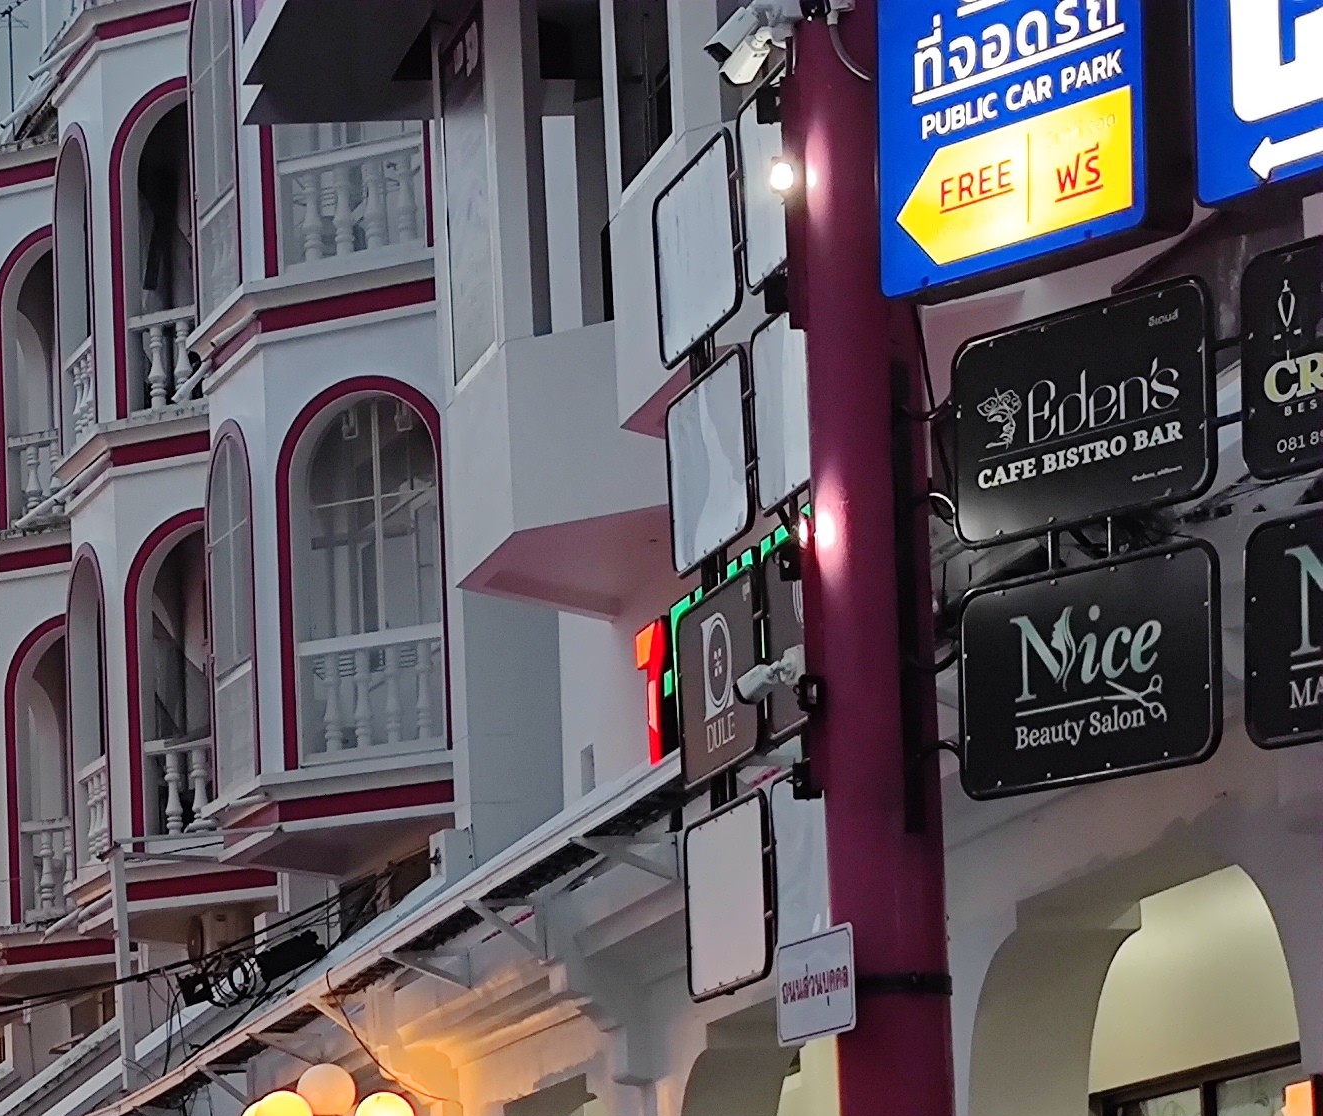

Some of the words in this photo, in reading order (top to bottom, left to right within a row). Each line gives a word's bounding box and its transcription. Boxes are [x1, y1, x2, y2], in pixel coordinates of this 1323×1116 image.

[921, 92, 998, 140] PUBLIC
[1006, 74, 1053, 111] CAR
[1060, 49, 1123, 93] PARK
[940, 159, 1013, 208] FREE
[1056, 142, 1102, 194] ฟรี
[1027, 356, 1180, 444] Eden's
[977, 458, 1037, 490] CAFE
[1042, 436, 1127, 475] BISTRO
[1132, 421, 1183, 450] BAR
[1276, 435, 1306, 453] 081
[1009, 605, 1162, 703] Nice
[1015, 719, 1086, 751] Beauty
[1089, 704, 1146, 737] Salon
[782, 963, 849, 1006] ถนนส่วนบุคคล
